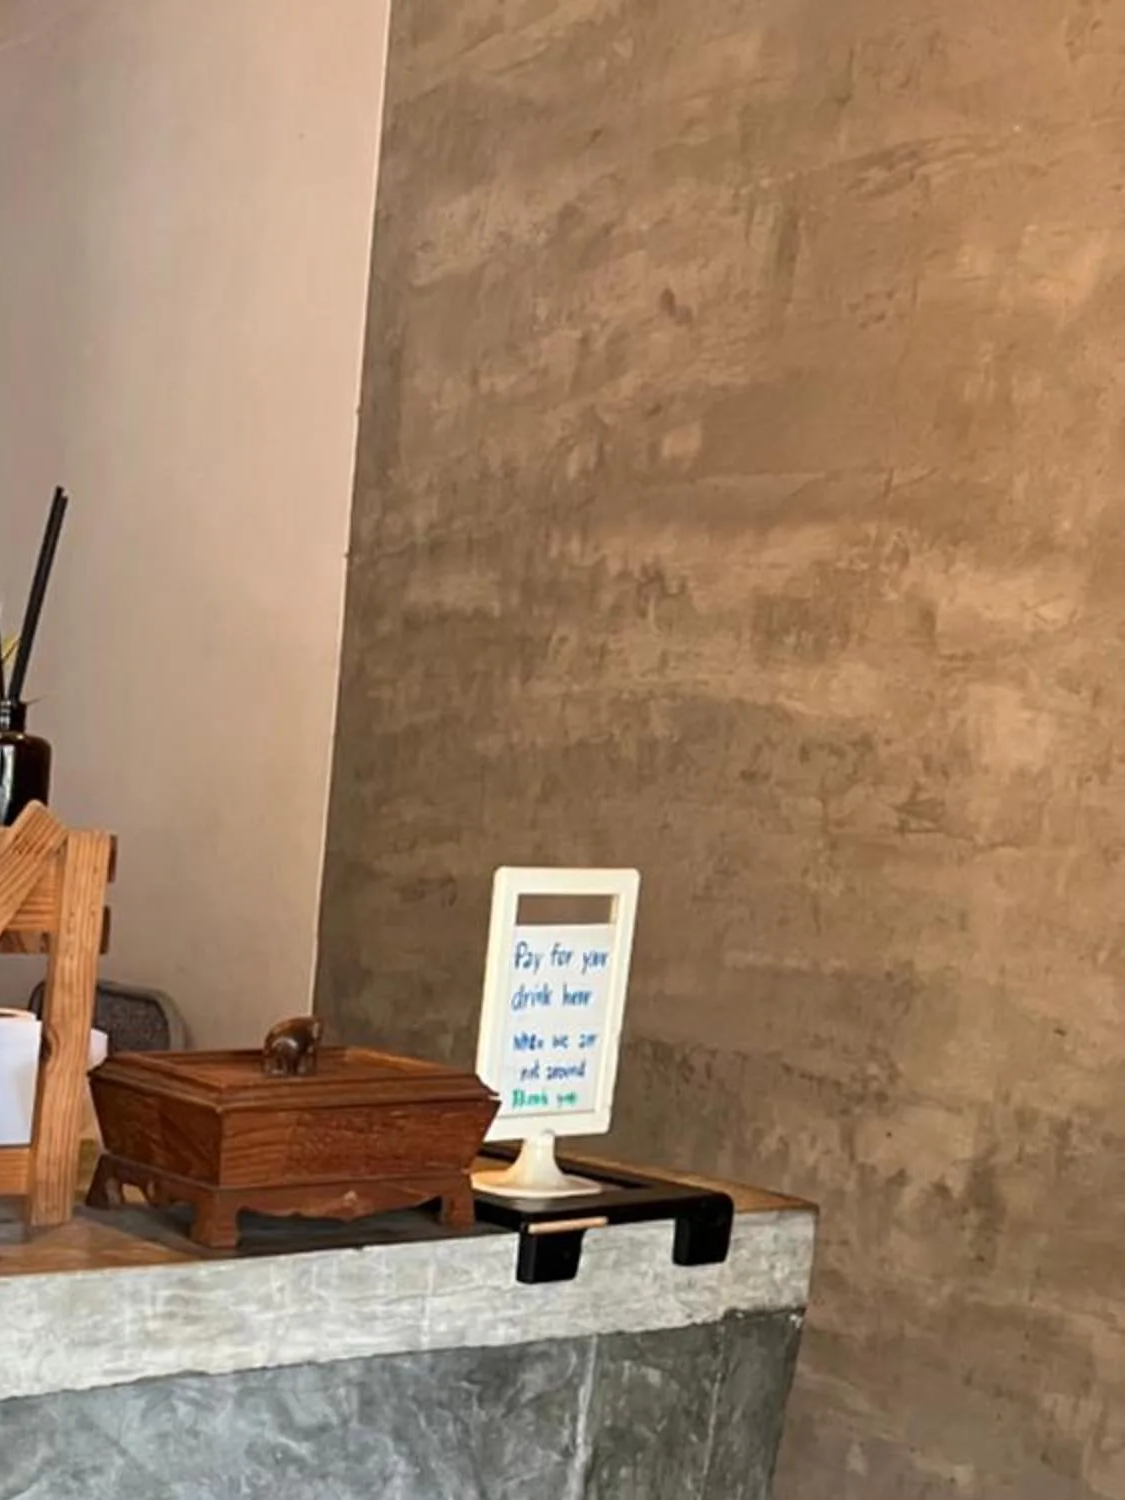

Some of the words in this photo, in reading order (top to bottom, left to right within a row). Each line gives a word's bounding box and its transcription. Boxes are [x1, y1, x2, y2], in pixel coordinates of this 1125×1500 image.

[513, 940, 542, 974] Pay
[550, 942, 574, 967] for
[510, 982, 553, 1012] drink
